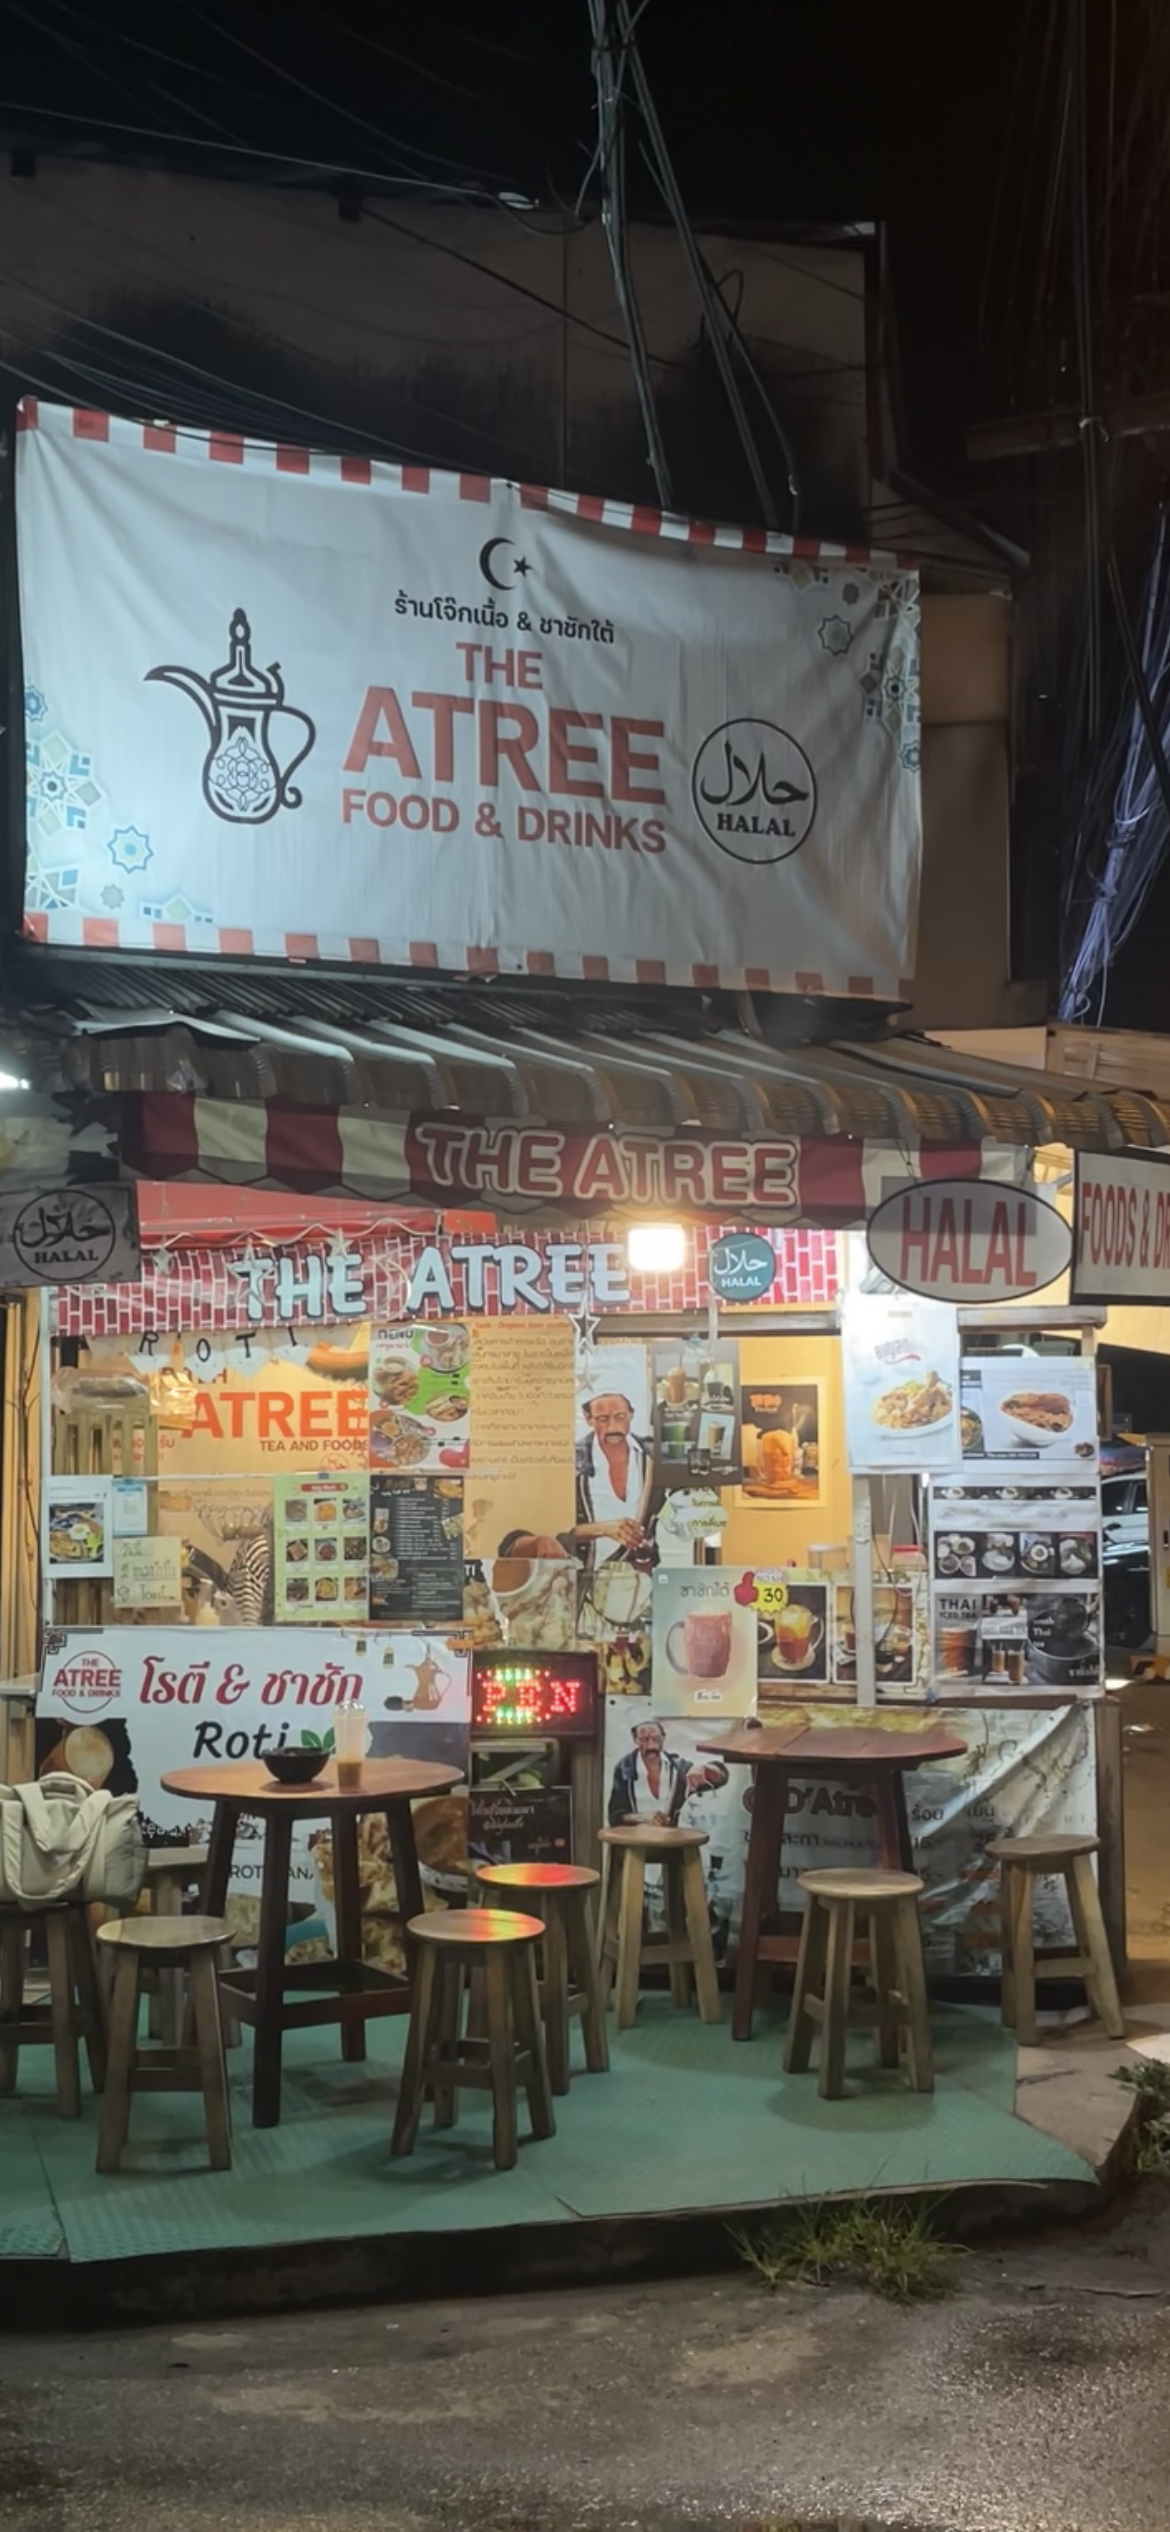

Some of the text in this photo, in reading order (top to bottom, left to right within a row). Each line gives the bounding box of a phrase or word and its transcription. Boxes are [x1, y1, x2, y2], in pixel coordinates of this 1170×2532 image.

[394, 589, 615, 644] ร้านโจ๊กเนื้อ & ชาชักใต้
[455, 641, 543, 690] THE
[342, 686, 667, 806] ATREE
[700, 740, 810, 807] حلال
[341, 787, 667, 854] FOOD & DRINKS
[715, 811, 797, 838] HALAL
[416, 1122, 801, 1207] THE ATREE
[899, 1195, 1038, 1287] HALAL
[1078, 1181, 1137, 1268] FOODS
[1139, 1187, 1150, 1269] &
[34, 1249, 99, 1264] HALAL
[713, 1246, 769, 1276] حلال
[232, 1243, 633, 1322] THE ATREE
[721, 1276, 762, 1288] HALAL
[181, 1391, 369, 1439] ATREE
[259, 1438, 369, 1452] TEA AND FOODS
[763, 1587, 784, 1604] 30
[939, 1598, 977, 1611] THAI
[53, 1668, 123, 1688] ATREE
[81, 1658, 99, 1667] THE
[138, 1655, 364, 1706] โรตี & ชาชัก
[52, 1688, 122, 1698] FOOD & DRINKS
[192, 1720, 291, 1760] Roti
[229, 1864, 266, 1879] ROT
